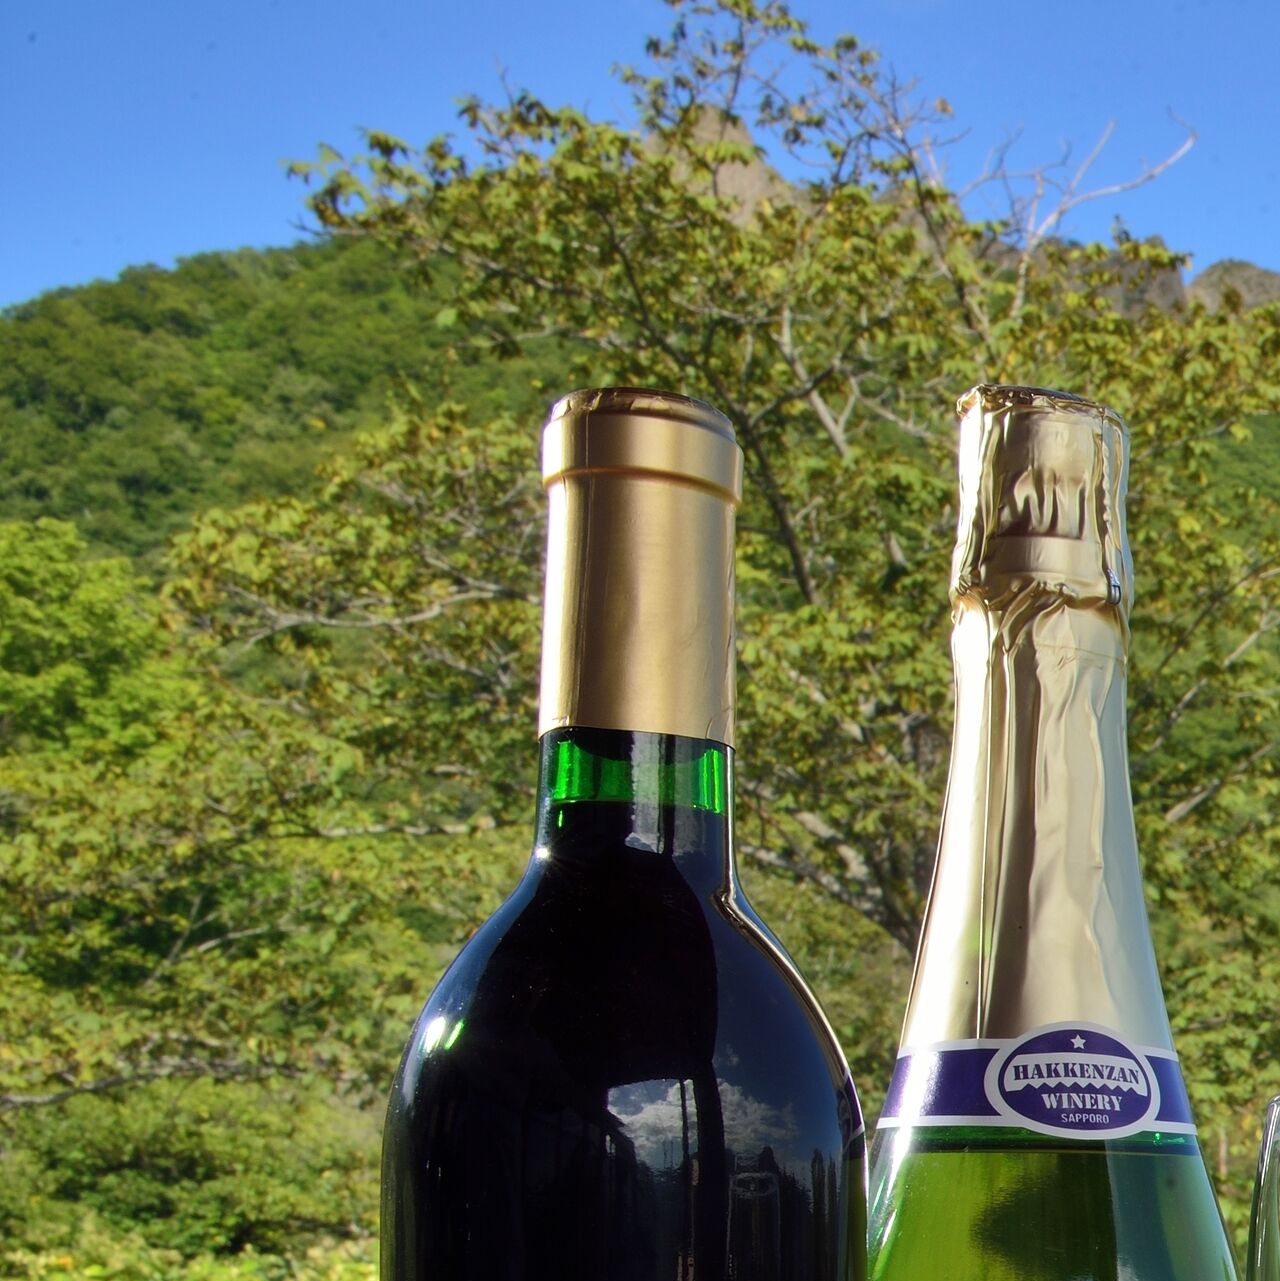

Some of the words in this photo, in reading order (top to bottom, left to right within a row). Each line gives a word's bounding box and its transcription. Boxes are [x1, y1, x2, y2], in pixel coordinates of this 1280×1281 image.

[1013, 1062, 1140, 1085] HAKKENZAN
[1042, 1093, 1122, 1111] WINERY
[1061, 1113, 1109, 1124] SAPPORO
